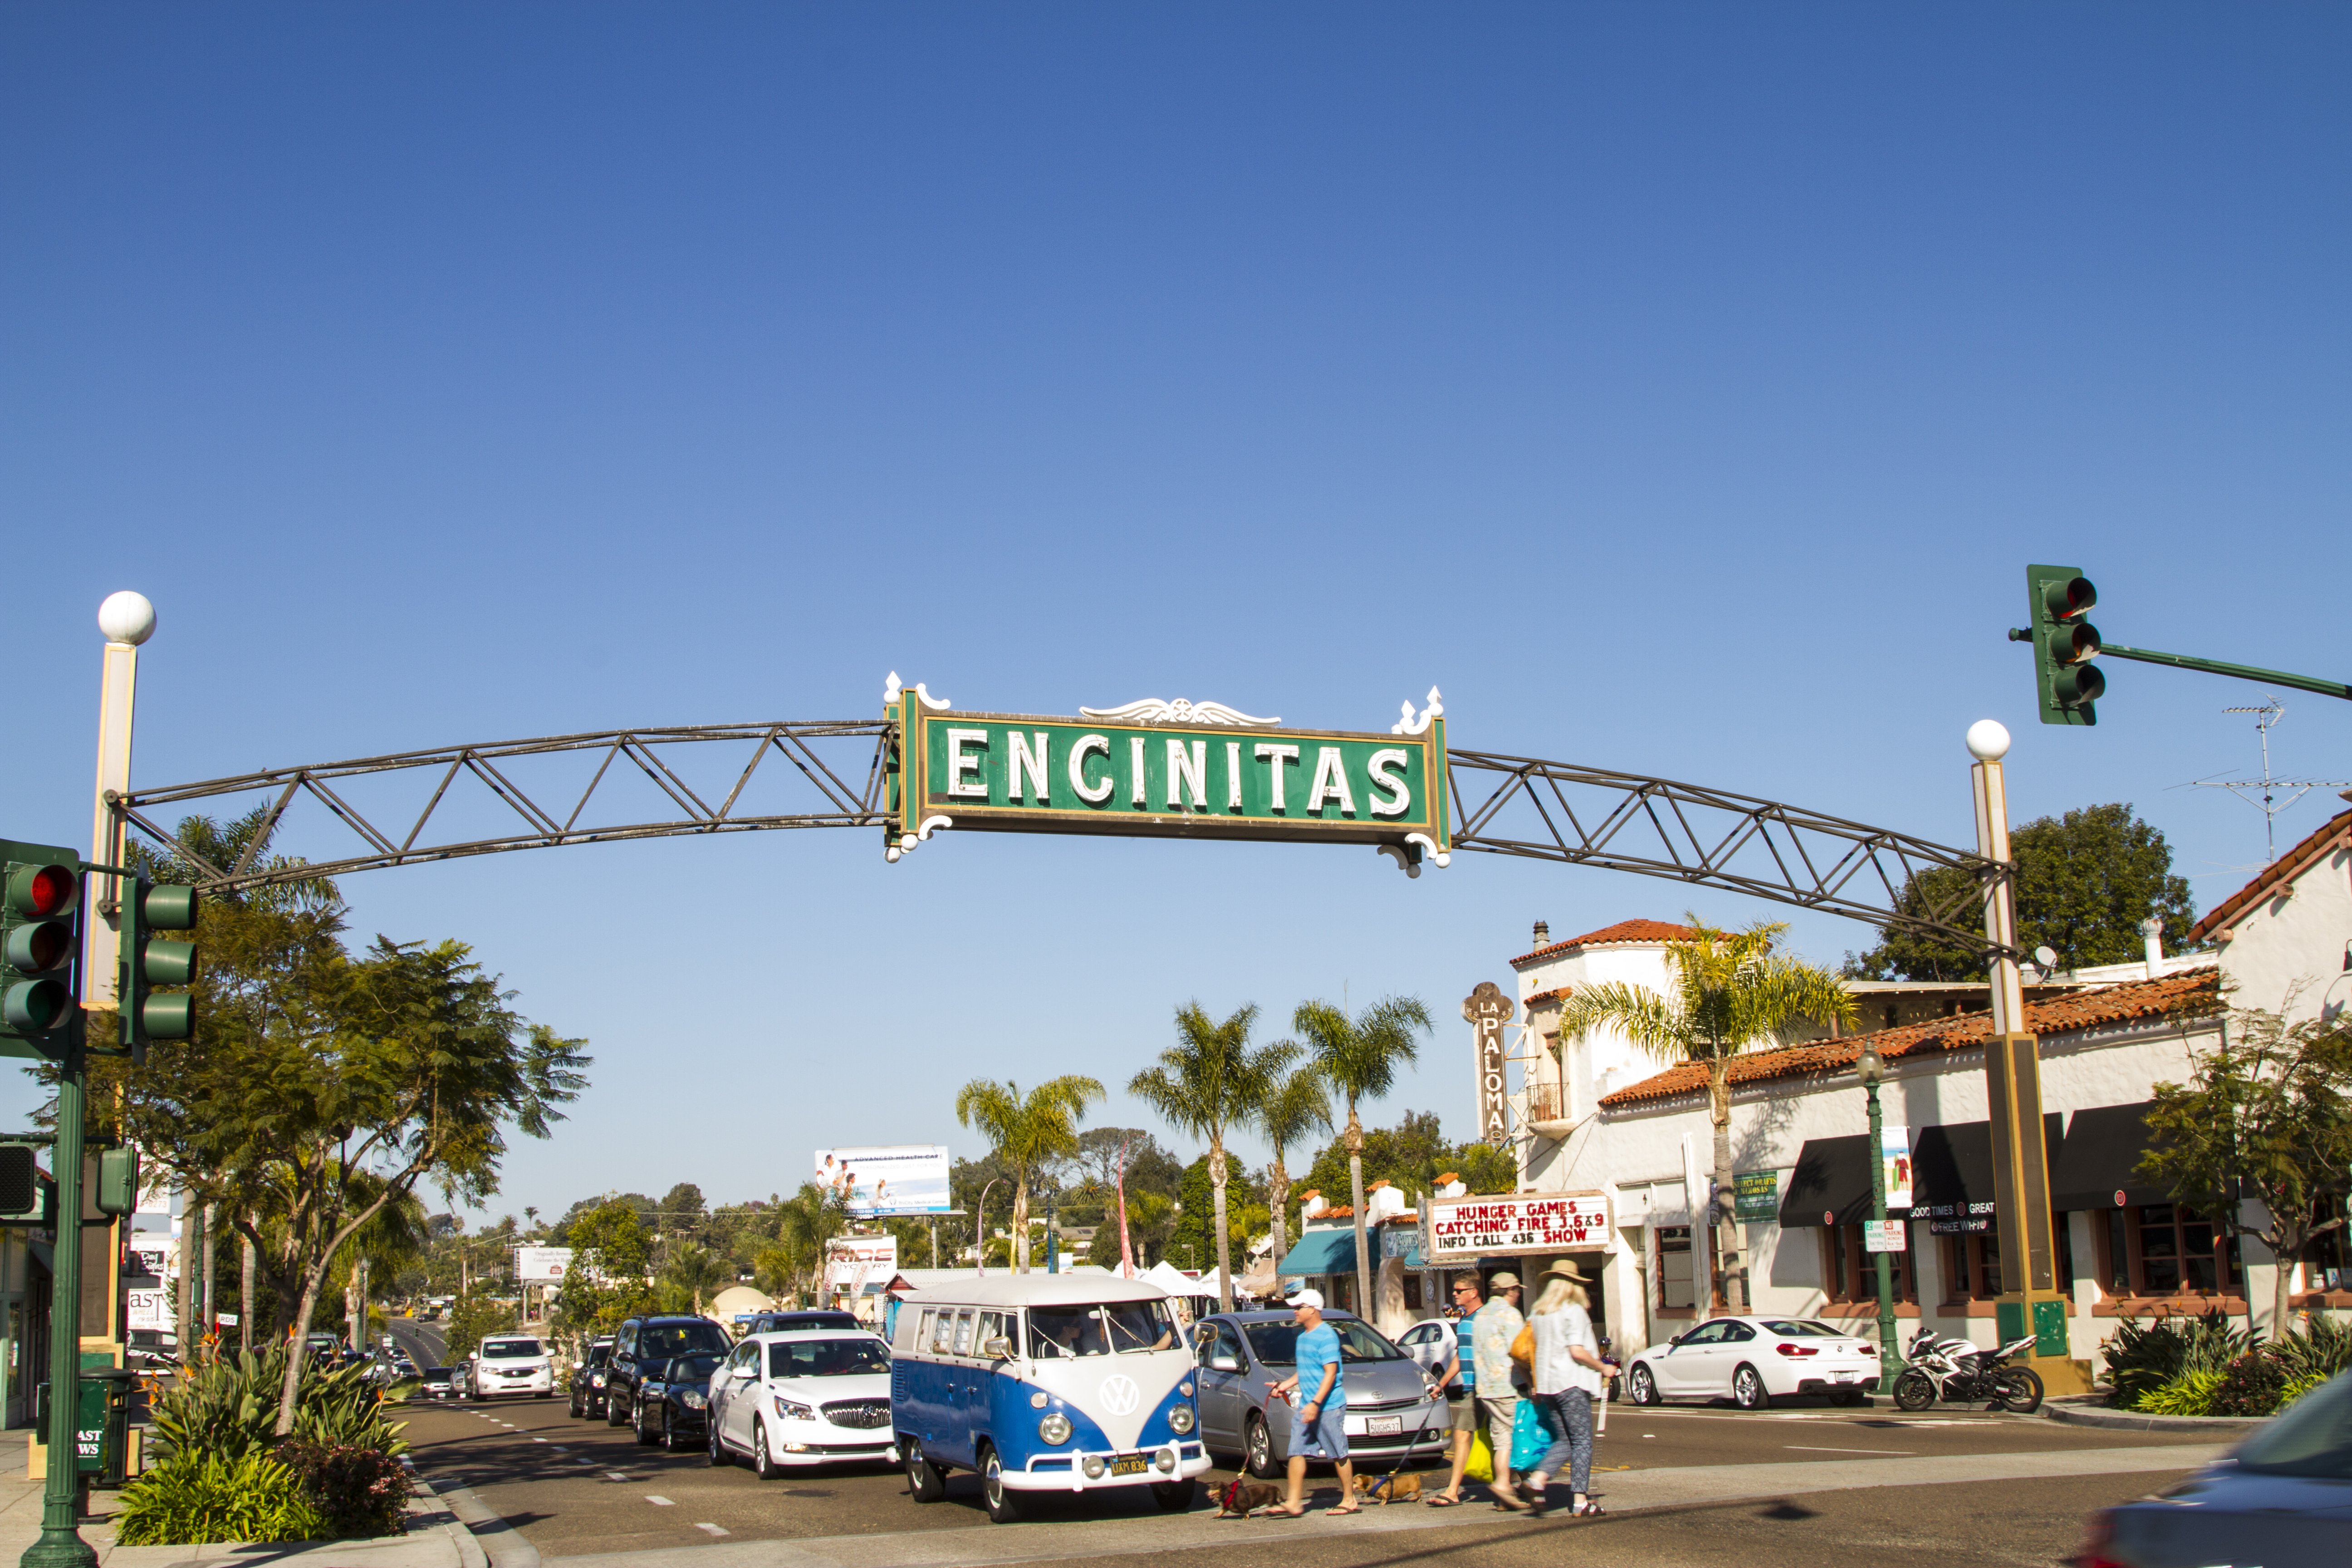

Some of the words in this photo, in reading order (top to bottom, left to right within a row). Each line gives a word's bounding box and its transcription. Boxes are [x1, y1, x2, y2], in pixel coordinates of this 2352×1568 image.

[947, 728, 1410, 816] ENCINITAS
[1480, 1002, 1499, 1013] LA
[1482, 1018, 1504, 1129] PALOMA
[1456, 1205, 1517, 1220] HUNGER
[1526, 1200, 1578, 1216] GAMES
[1910, 1207, 1931, 1217] GOOD
[1931, 1205, 1953, 1216] TIMES
[1969, 1202, 1994, 1214] GREAT
[1436, 1219, 1509, 1235] CATCHING
[1518, 1215, 1550, 1231] FIRE
[1938, 1221, 1960, 1232] FREE
[1439, 1236, 1466, 1249] INFO
[1474, 1234, 1504, 1247] CALL
[1511, 1232, 1534, 1245] 436
[1543, 1228, 1588, 1244] SHOW
[140, 1252, 159, 1264] Day
[831, 1248, 894, 1262] RIDE
[853, 1263, 867, 1291] RIDE
[1371, 1422, 1399, 1433] 5UGH537
[1112, 1461, 1130, 1474] UXM
[1131, 1460, 1147, 1472] 836
